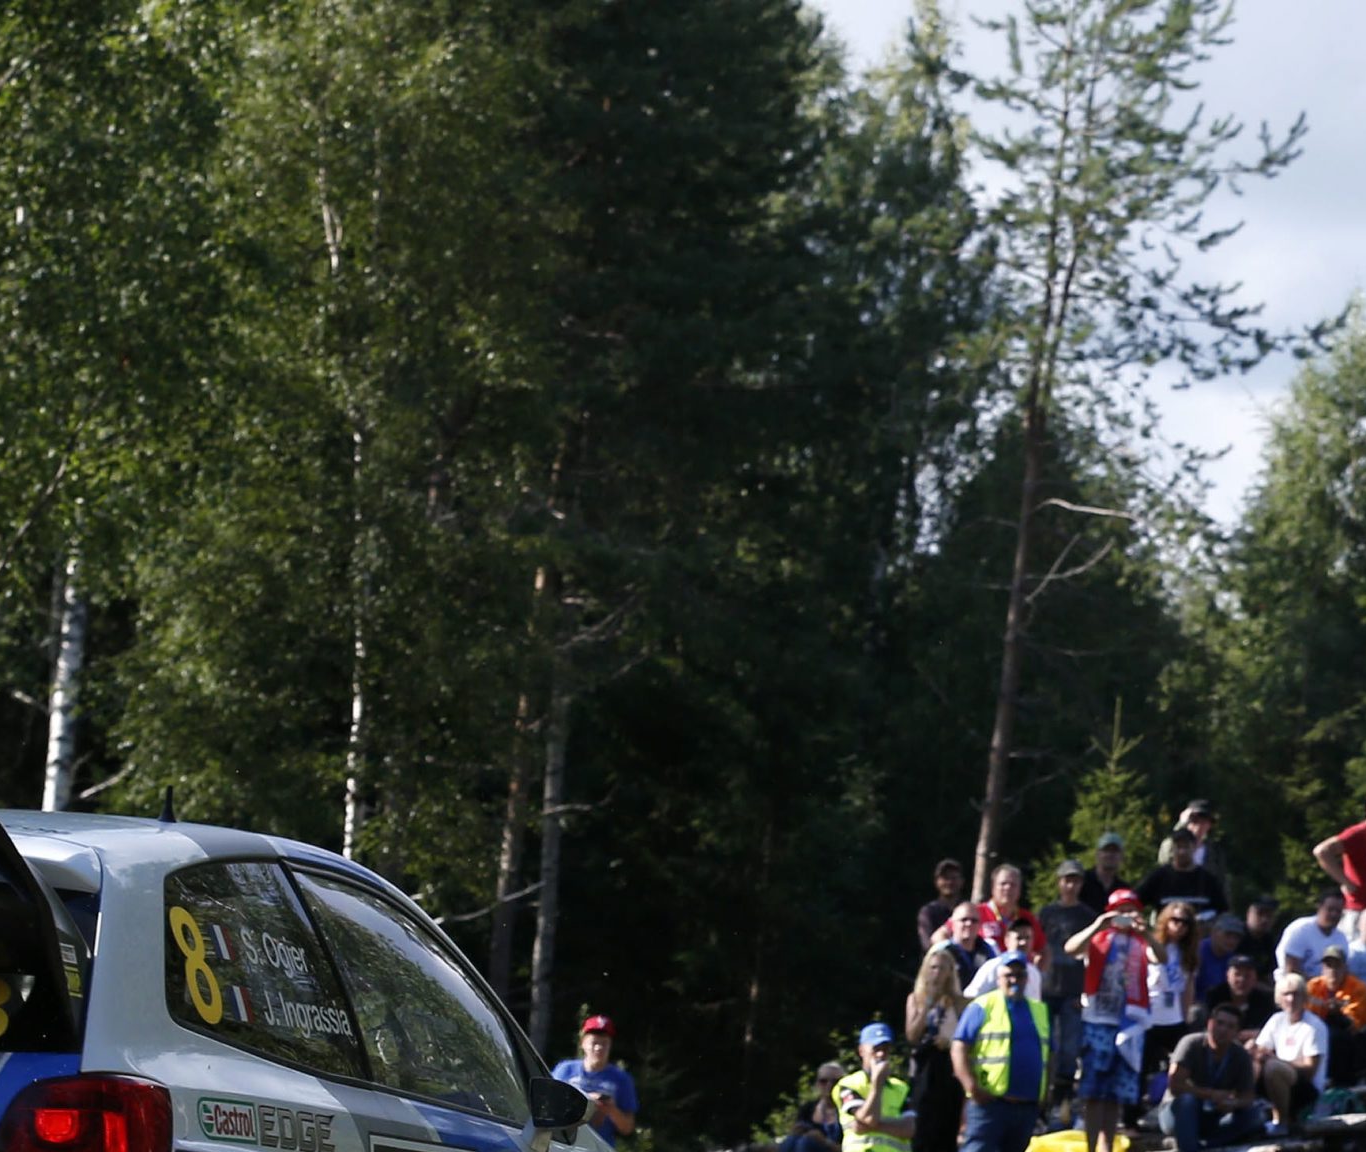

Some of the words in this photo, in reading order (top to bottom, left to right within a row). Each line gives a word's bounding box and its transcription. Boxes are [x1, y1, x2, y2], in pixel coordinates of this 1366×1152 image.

[169, 906, 223, 1024] 8
[262, 931, 309, 978] Ogier
[280, 992, 353, 1038] Ingrassia
[213, 1104, 255, 1137] Castrol
